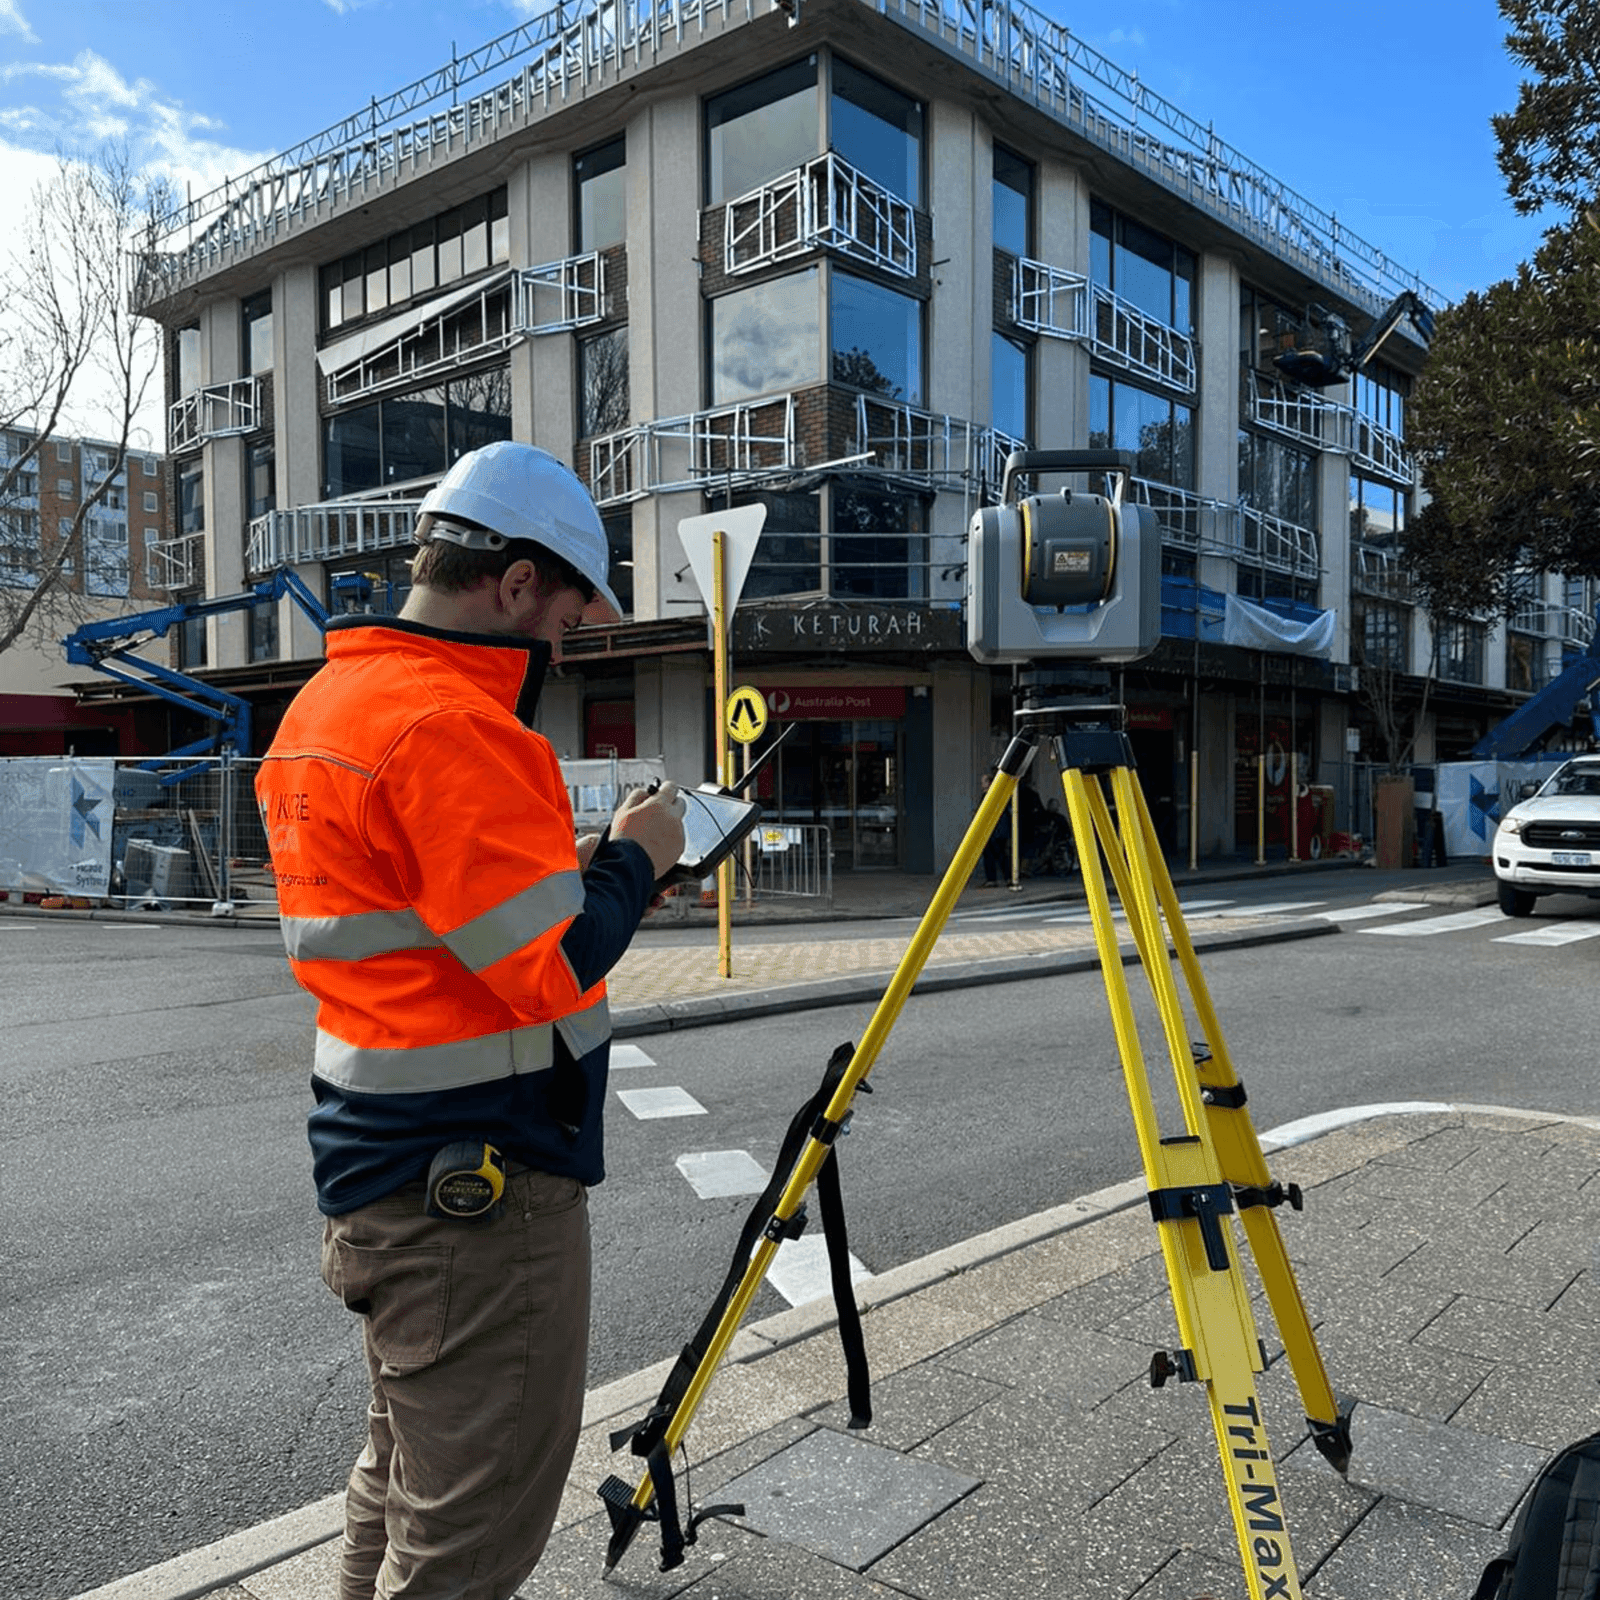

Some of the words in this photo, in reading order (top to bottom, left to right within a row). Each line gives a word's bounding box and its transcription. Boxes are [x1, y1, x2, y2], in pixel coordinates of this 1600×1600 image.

[794, 614, 921, 635] KETURAH
[794, 696, 843, 708] Australia
[845, 696, 871, 708] Post
[1224, 1396, 1292, 1600] Tri-Max
